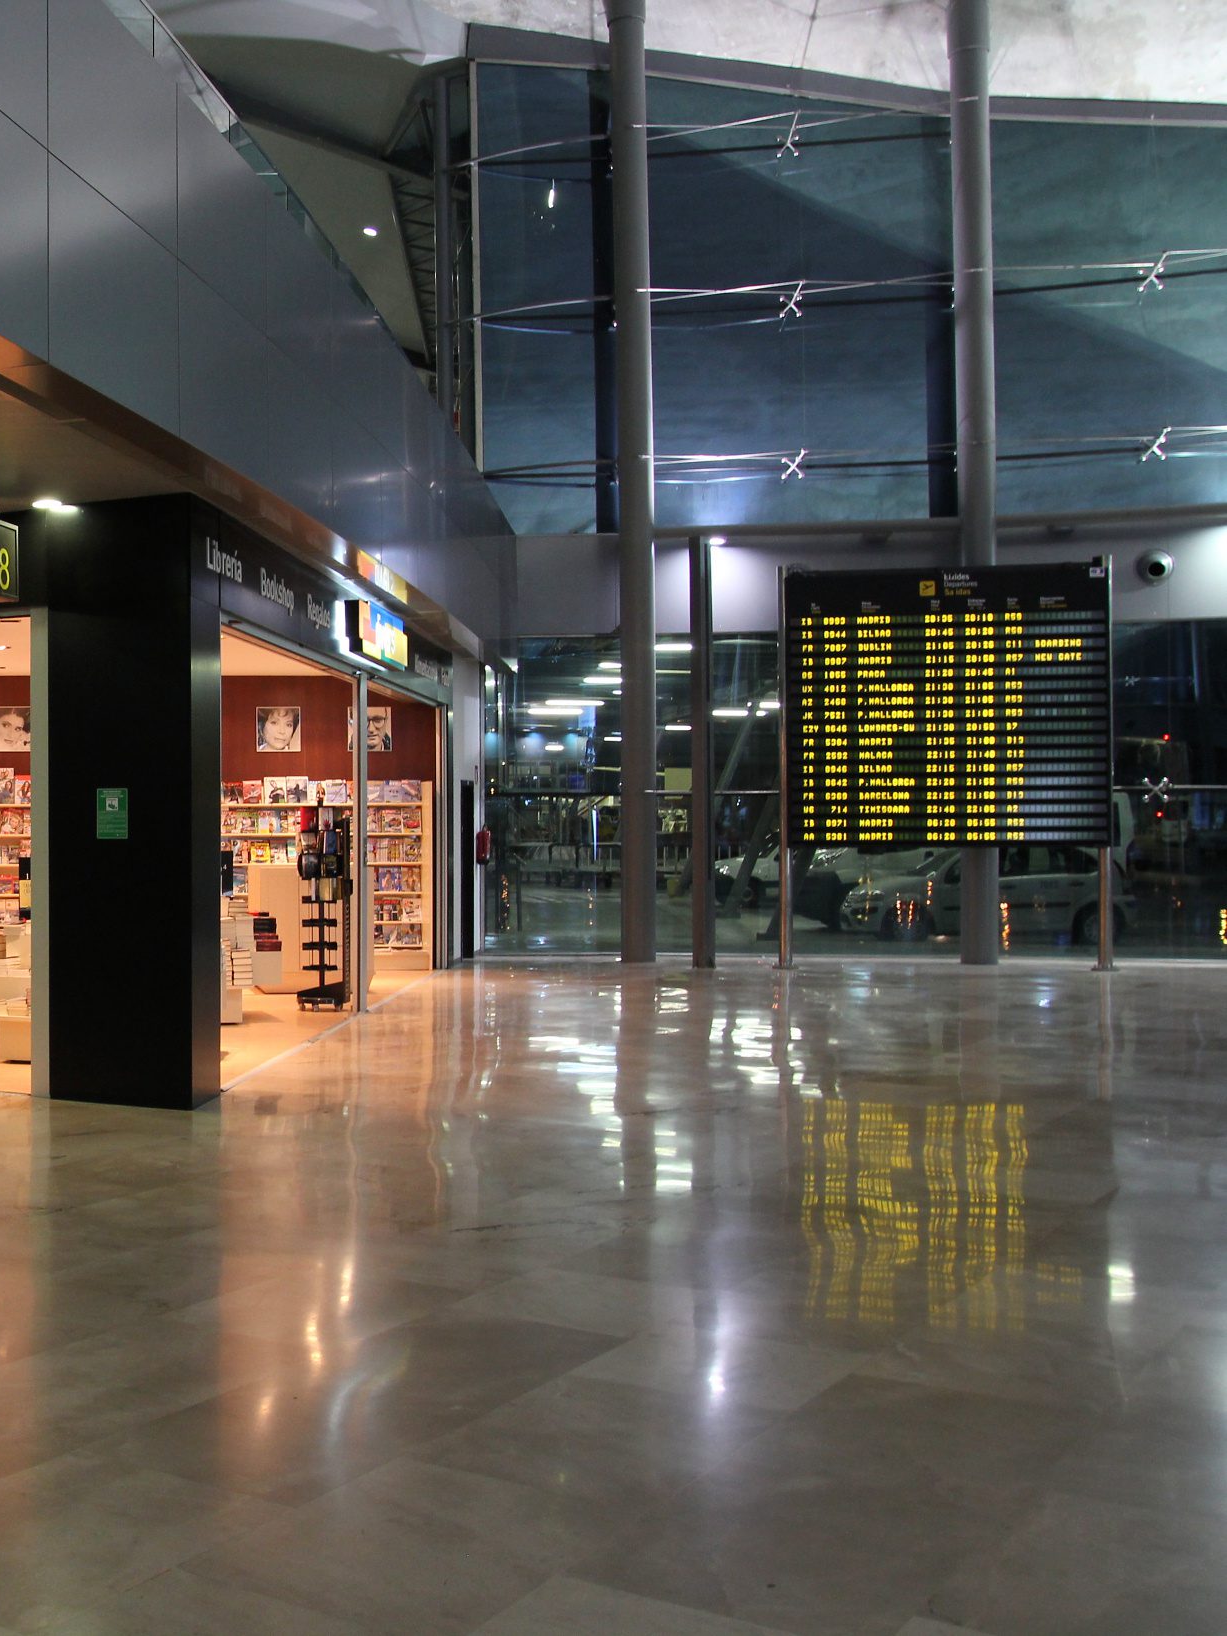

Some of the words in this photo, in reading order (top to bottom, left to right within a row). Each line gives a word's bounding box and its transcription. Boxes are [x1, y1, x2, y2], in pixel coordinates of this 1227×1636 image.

[206, 537, 243, 584] Librería
[260, 567, 295, 616] Bookshop
[307, 594, 331, 629] Regalos
[801, 617, 813, 626] IB
[856, 615, 891, 625] MADRID
[924, 613, 954, 624] 20:35
[801, 630, 813, 640] IB
[857, 628, 892, 639] BILBAO
[802, 644, 814, 653] FR
[857, 642, 893, 652] DUBLIN
[1034, 638, 1082, 649] BOARDING
[802, 657, 814, 666] IB
[857, 655, 893, 665] MADRID
[1057, 652, 1082, 662] GATE
[801, 685, 813, 694] UX
[801, 697, 814, 707] AZ
[802, 738, 815, 747] FR
[858, 737, 894, 747] MADRID
[803, 751, 815, 760] FR
[926, 749, 956, 760] 22:15
[802, 765, 814, 774] IB
[858, 764, 893, 774] BILBAO
[925, 763, 955, 773] 22:15
[803, 778, 815, 787] IB
[802, 791, 815, 801] FR
[858, 791, 911, 801] BARCELONA
[803, 818, 815, 828] IB
[858, 818, 894, 828] MADRID
[858, 831, 894, 841] MADRID
